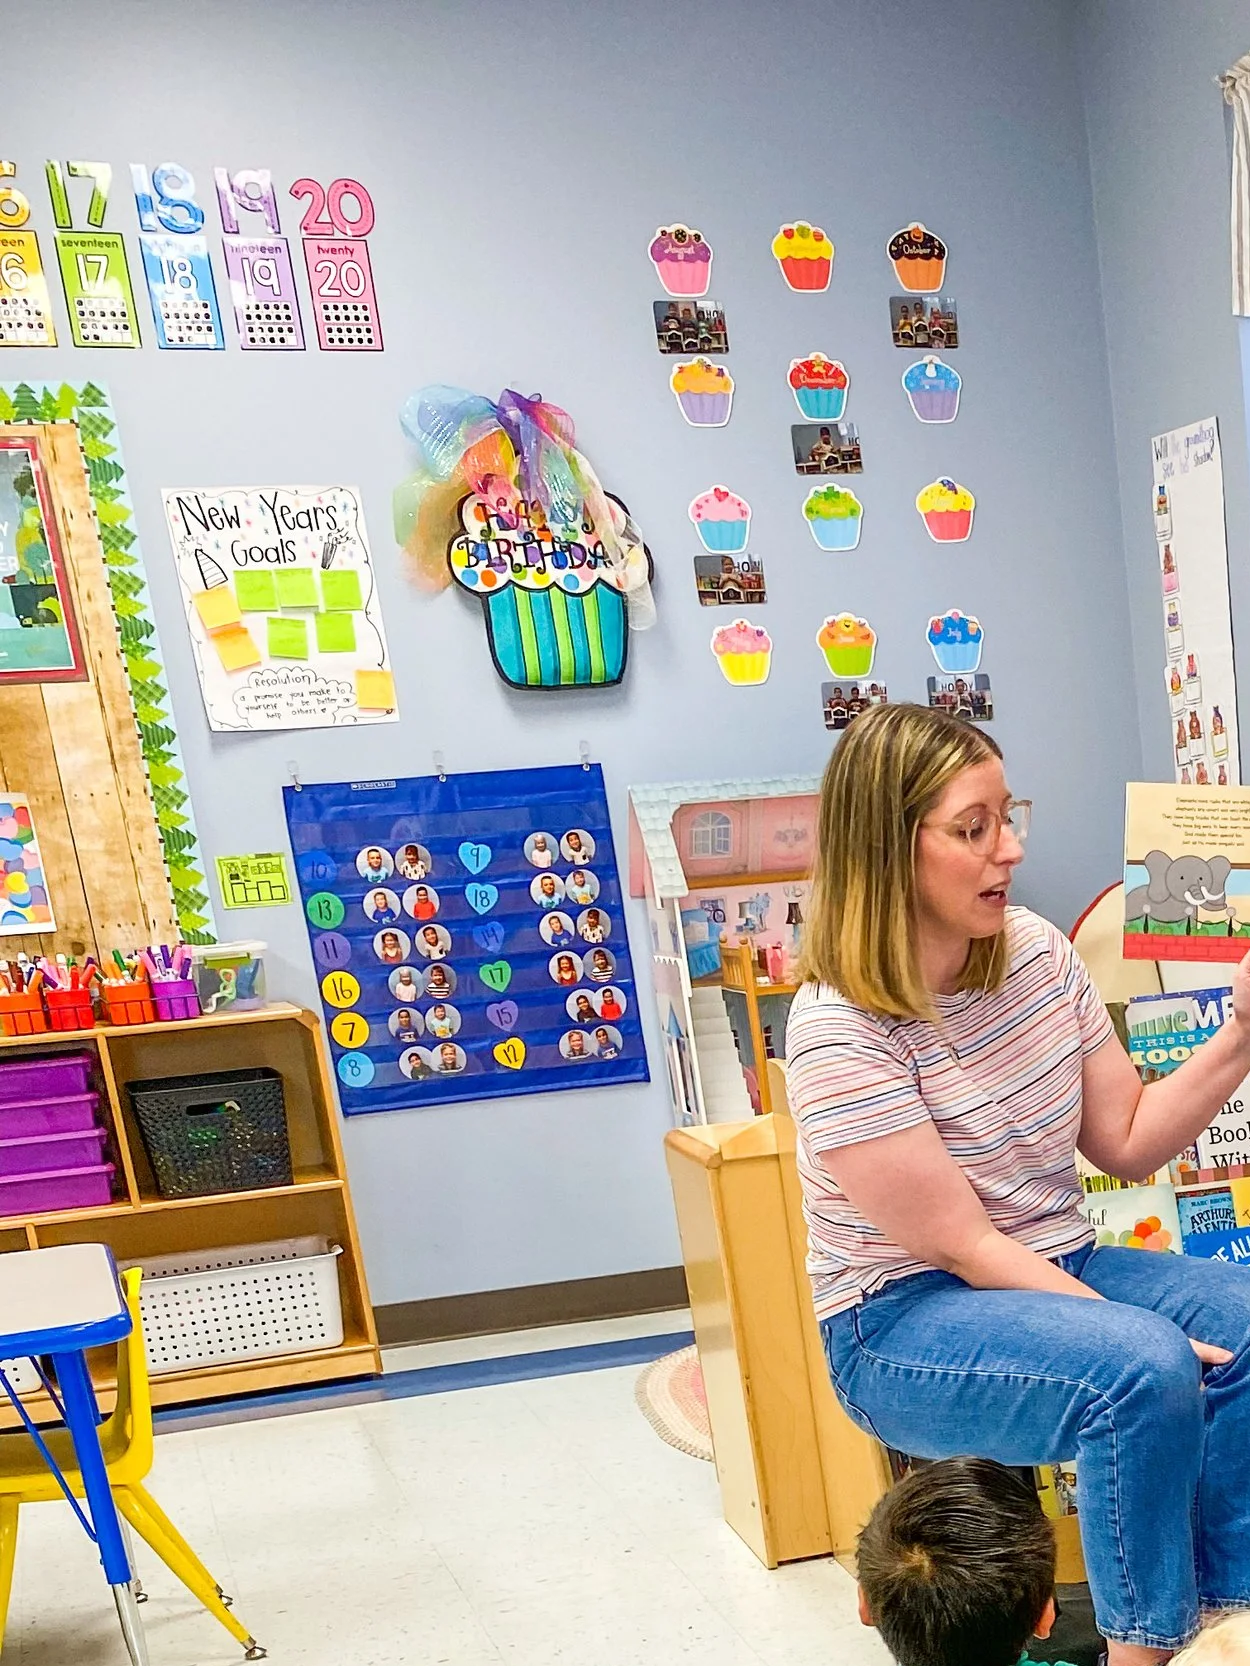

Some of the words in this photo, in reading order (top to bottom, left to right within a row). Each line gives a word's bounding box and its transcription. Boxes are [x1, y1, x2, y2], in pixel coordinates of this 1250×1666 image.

[0, 160, 30, 227] 6
[45, 159, 112, 228] 17
[128, 161, 205, 234] 18
[214, 167, 281, 234] 19
[289, 178, 374, 235] 20
[0, 238, 25, 247] een
[61, 238, 119, 249] seventeen
[317, 245, 355, 257] twenty
[0, 252, 28, 291] 6
[76, 253, 109, 291] 17
[161, 256, 199, 294] 18
[243, 257, 281, 295] 19
[317, 260, 365, 297] 20
[176, 495, 241, 535] New
[259, 491, 337, 535] Years
[230, 538, 296, 566] Goals
[457, 537, 634, 574] BIRTHDA
[254, 674, 311, 687] Resolution
[470, 848, 480, 867] 9
[474, 890, 490, 909] 18
[317, 899, 332, 921] 13
[481, 927, 499, 946] 14
[323, 939, 338, 960] 11
[488, 967, 504, 985] 17
[331, 978, 353, 1001] 16
[496, 1007, 513, 1025] 15
[341, 1021, 356, 1042] 7
[1133, 1037, 1176, 1048] THIS
[1179, 1034, 1195, 1043] IS
[503, 1044, 519, 1063] 12
[349, 1060, 361, 1077] 8
[1219, 1099, 1244, 1115] he
[1087, 1209, 1107, 1226] ful
